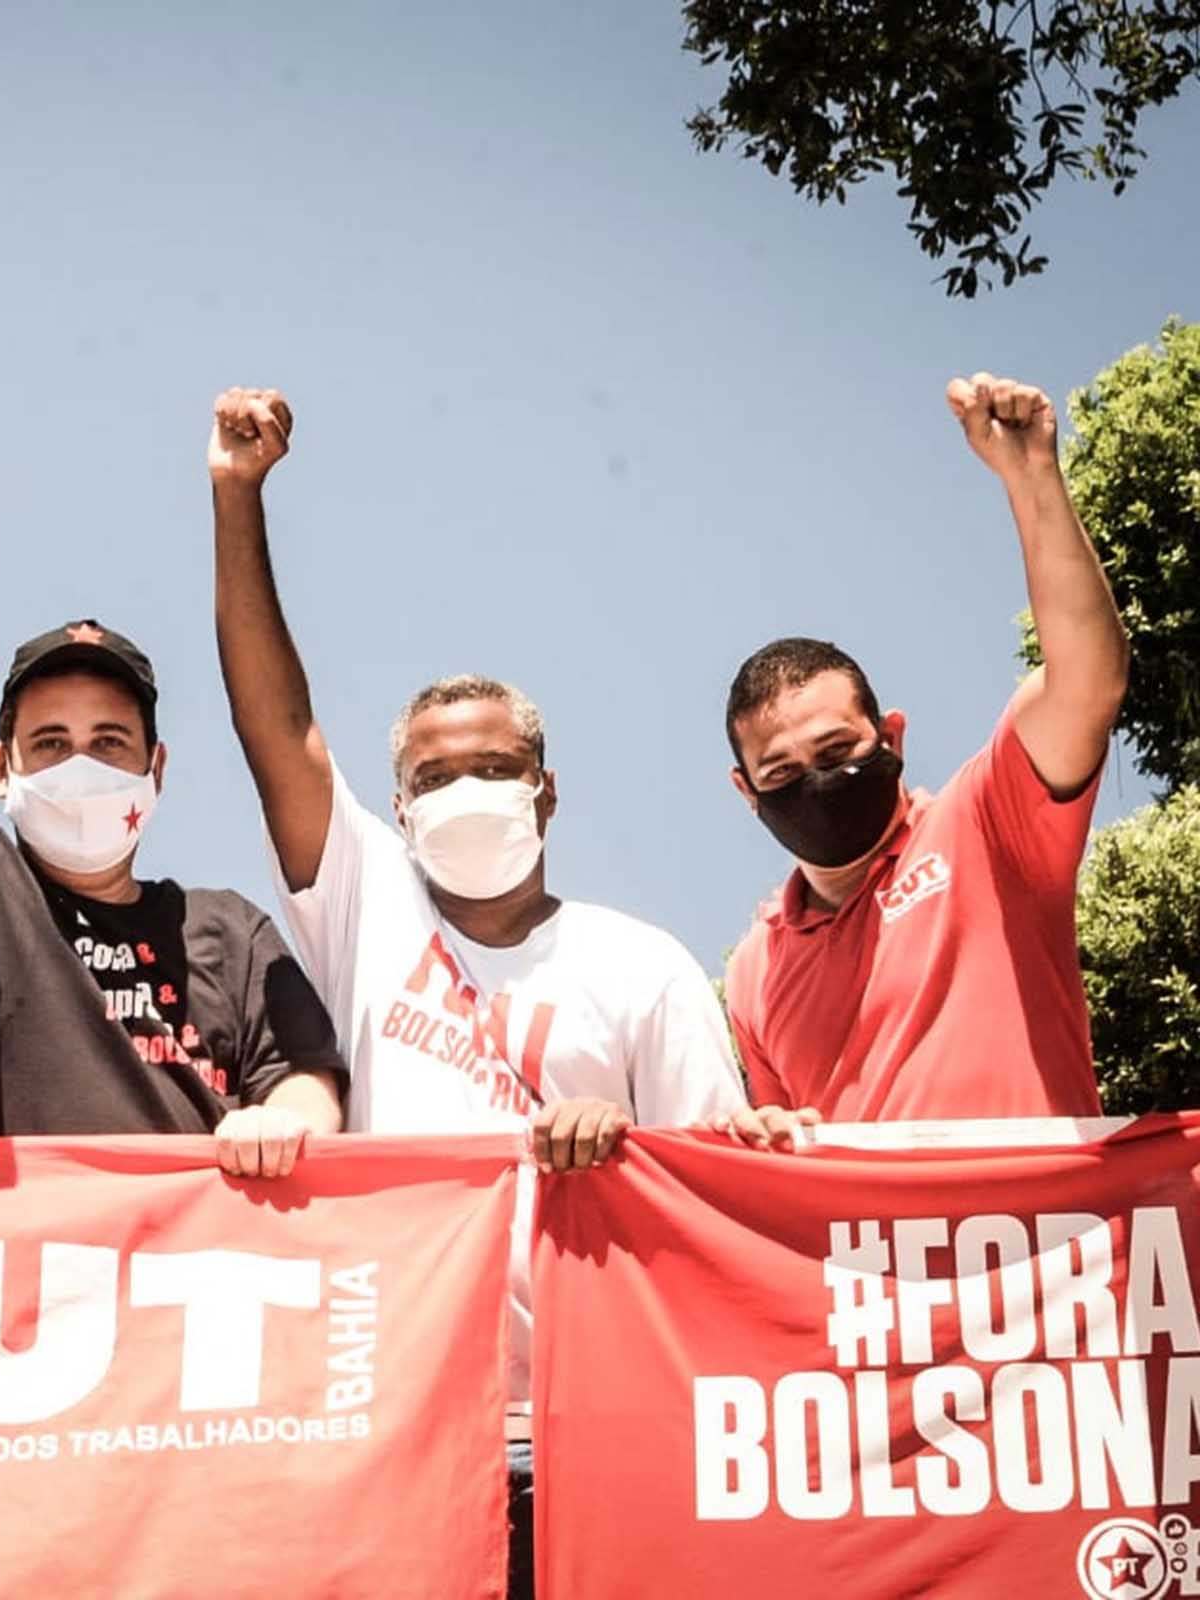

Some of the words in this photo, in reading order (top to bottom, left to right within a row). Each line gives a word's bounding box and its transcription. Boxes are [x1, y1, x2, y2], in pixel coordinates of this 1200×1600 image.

[878, 855, 940, 911] CUT
[823, 1206, 1200, 1368] #FORA
[325, 1260, 380, 1412] BAHIA
[68, 1412, 370, 1457] TRABALHADORES
[1111, 1557, 1140, 1578] PT
